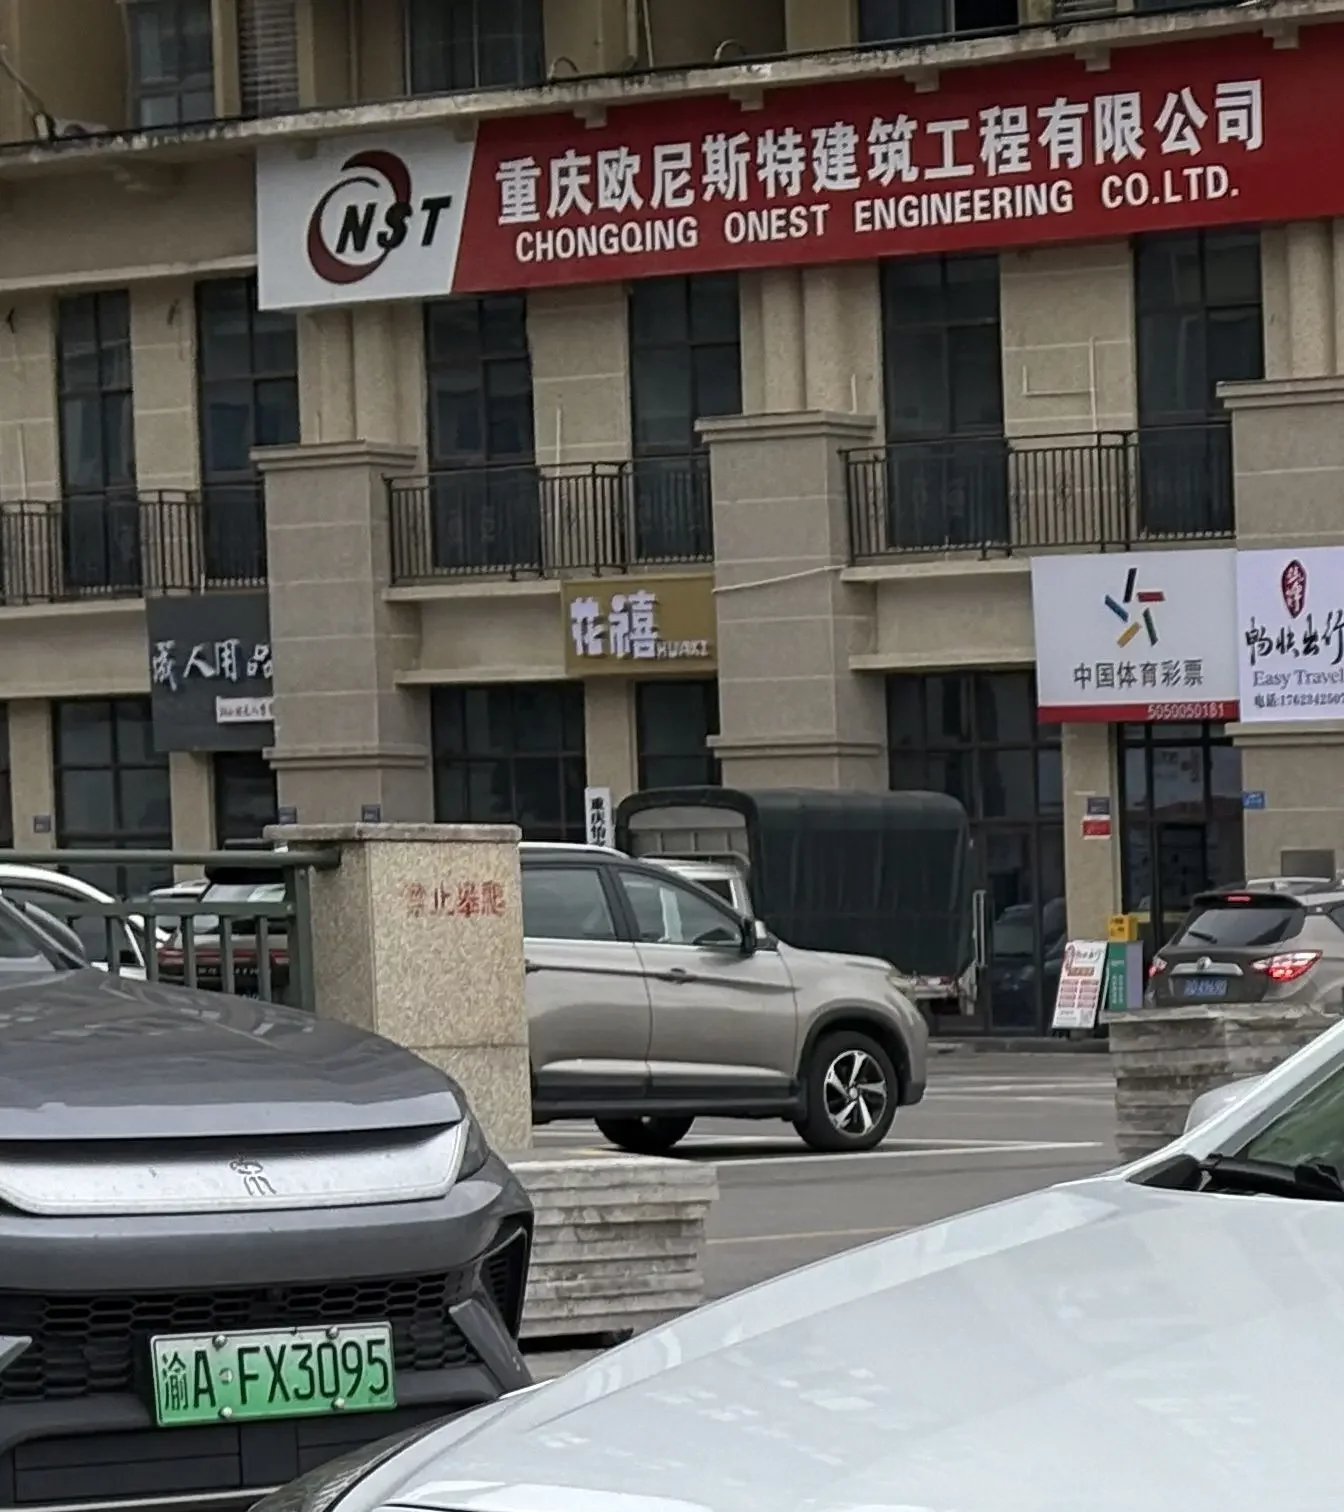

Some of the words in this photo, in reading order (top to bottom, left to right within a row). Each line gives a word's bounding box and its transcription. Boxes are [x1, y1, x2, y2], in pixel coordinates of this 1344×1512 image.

[496, 79, 1263, 226] 重庆欧尼斯特建筑工程有限公司
[515, 216, 699, 263] CHONGQING
[724, 203, 830, 243] ONEST
[854, 179, 1074, 234] ENGINEERING
[153, 638, 273, 691] 成人用品
[1073, 659, 1203, 690] 中国体育彩票
[1253, 670, 1291, 690] Easy
[1294, 668, 1344, 685] Travel
[403, 879, 505, 918] 禁止攀爬
